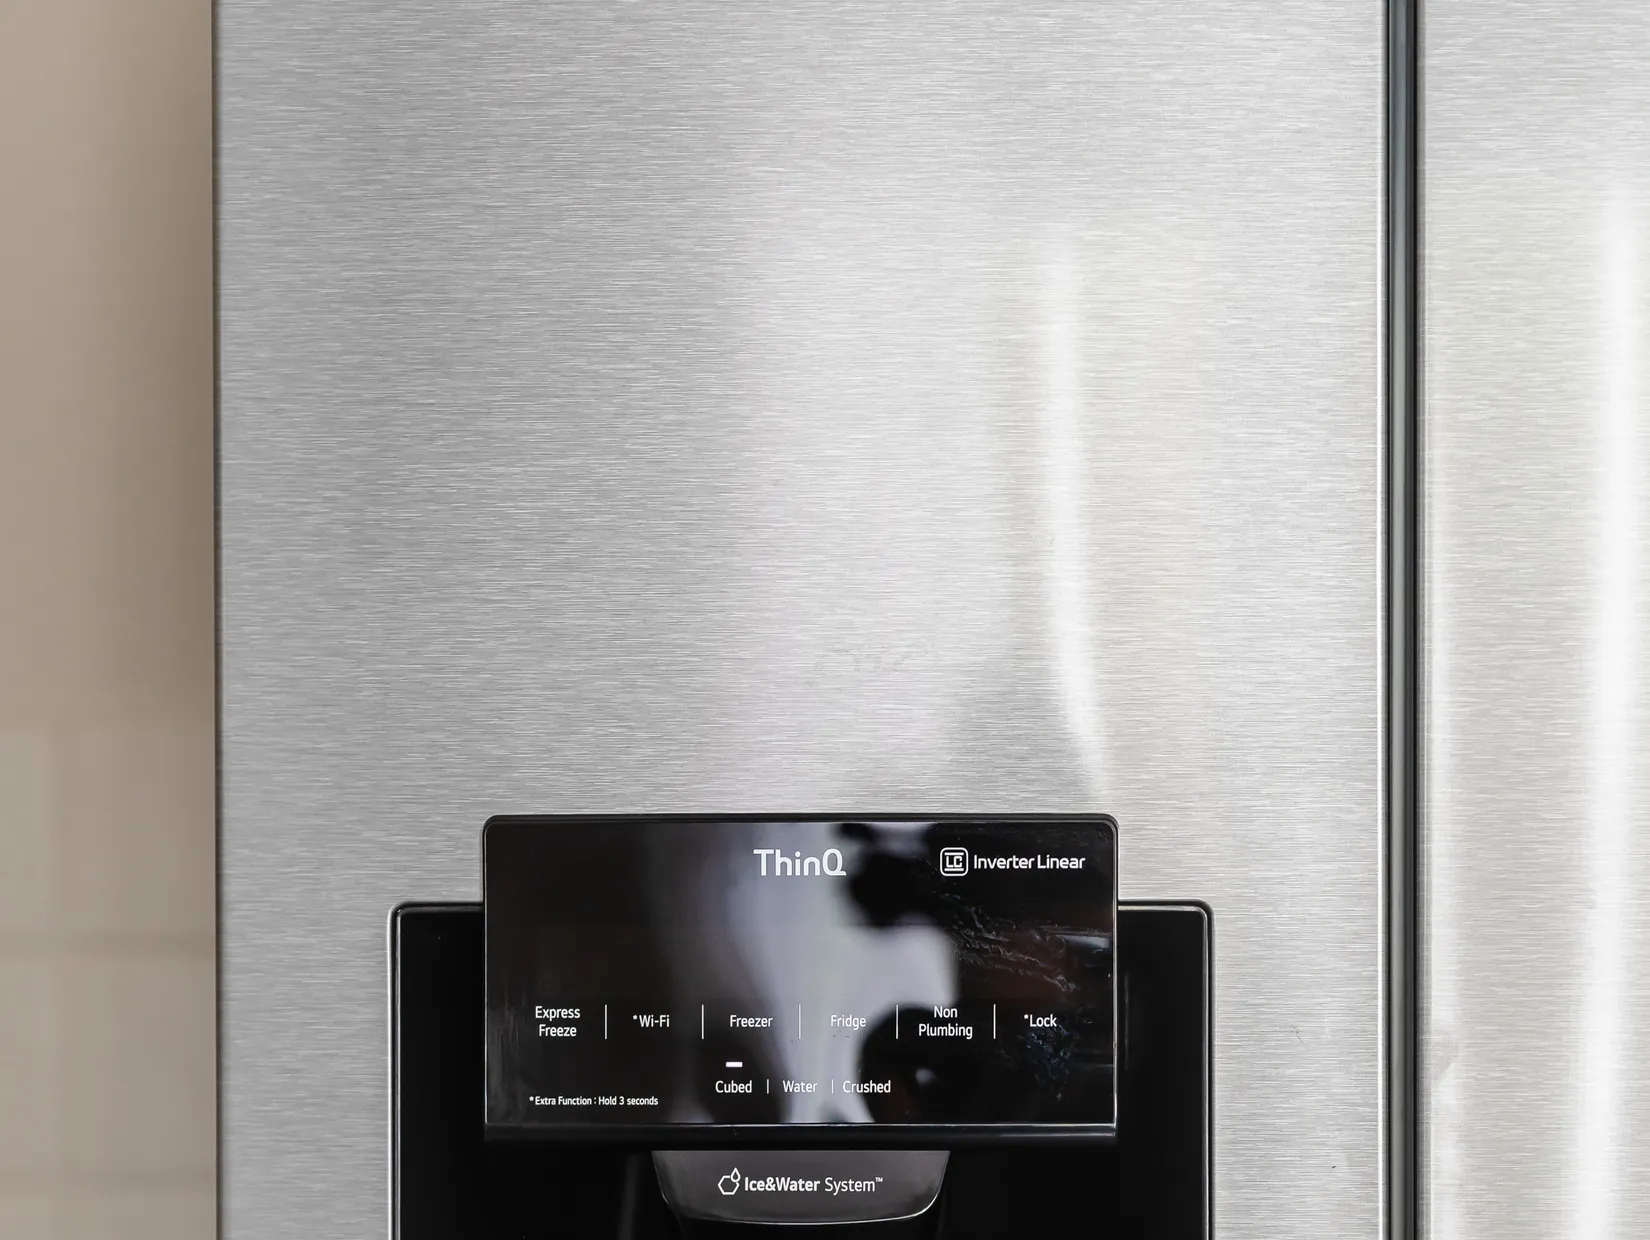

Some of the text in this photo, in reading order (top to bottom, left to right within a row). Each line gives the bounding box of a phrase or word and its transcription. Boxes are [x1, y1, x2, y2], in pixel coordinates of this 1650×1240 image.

[753, 848, 847, 876] ThinQ
[973, 854, 1035, 869] Inverter
[1037, 854, 1086, 869] Linear
[535, 1005, 581, 1022] Express
[934, 1005, 958, 1018] Non
[729, 1014, 773, 1028] Freezer
[830, 1014, 867, 1030] Fridge
[538, 1023, 577, 1037] Freeze
[918, 1023, 973, 1039] Plumbing
[715, 1080, 752, 1093] Cubed
[783, 1080, 817, 1093] Water
[842, 1080, 891, 1093] Crushed
[598, 1095, 617, 1106] Hold
[619, 1096, 625, 1106] 3
[626, 1095, 659, 1106] seconds
[744, 1177, 820, 1191] Ice&Water
